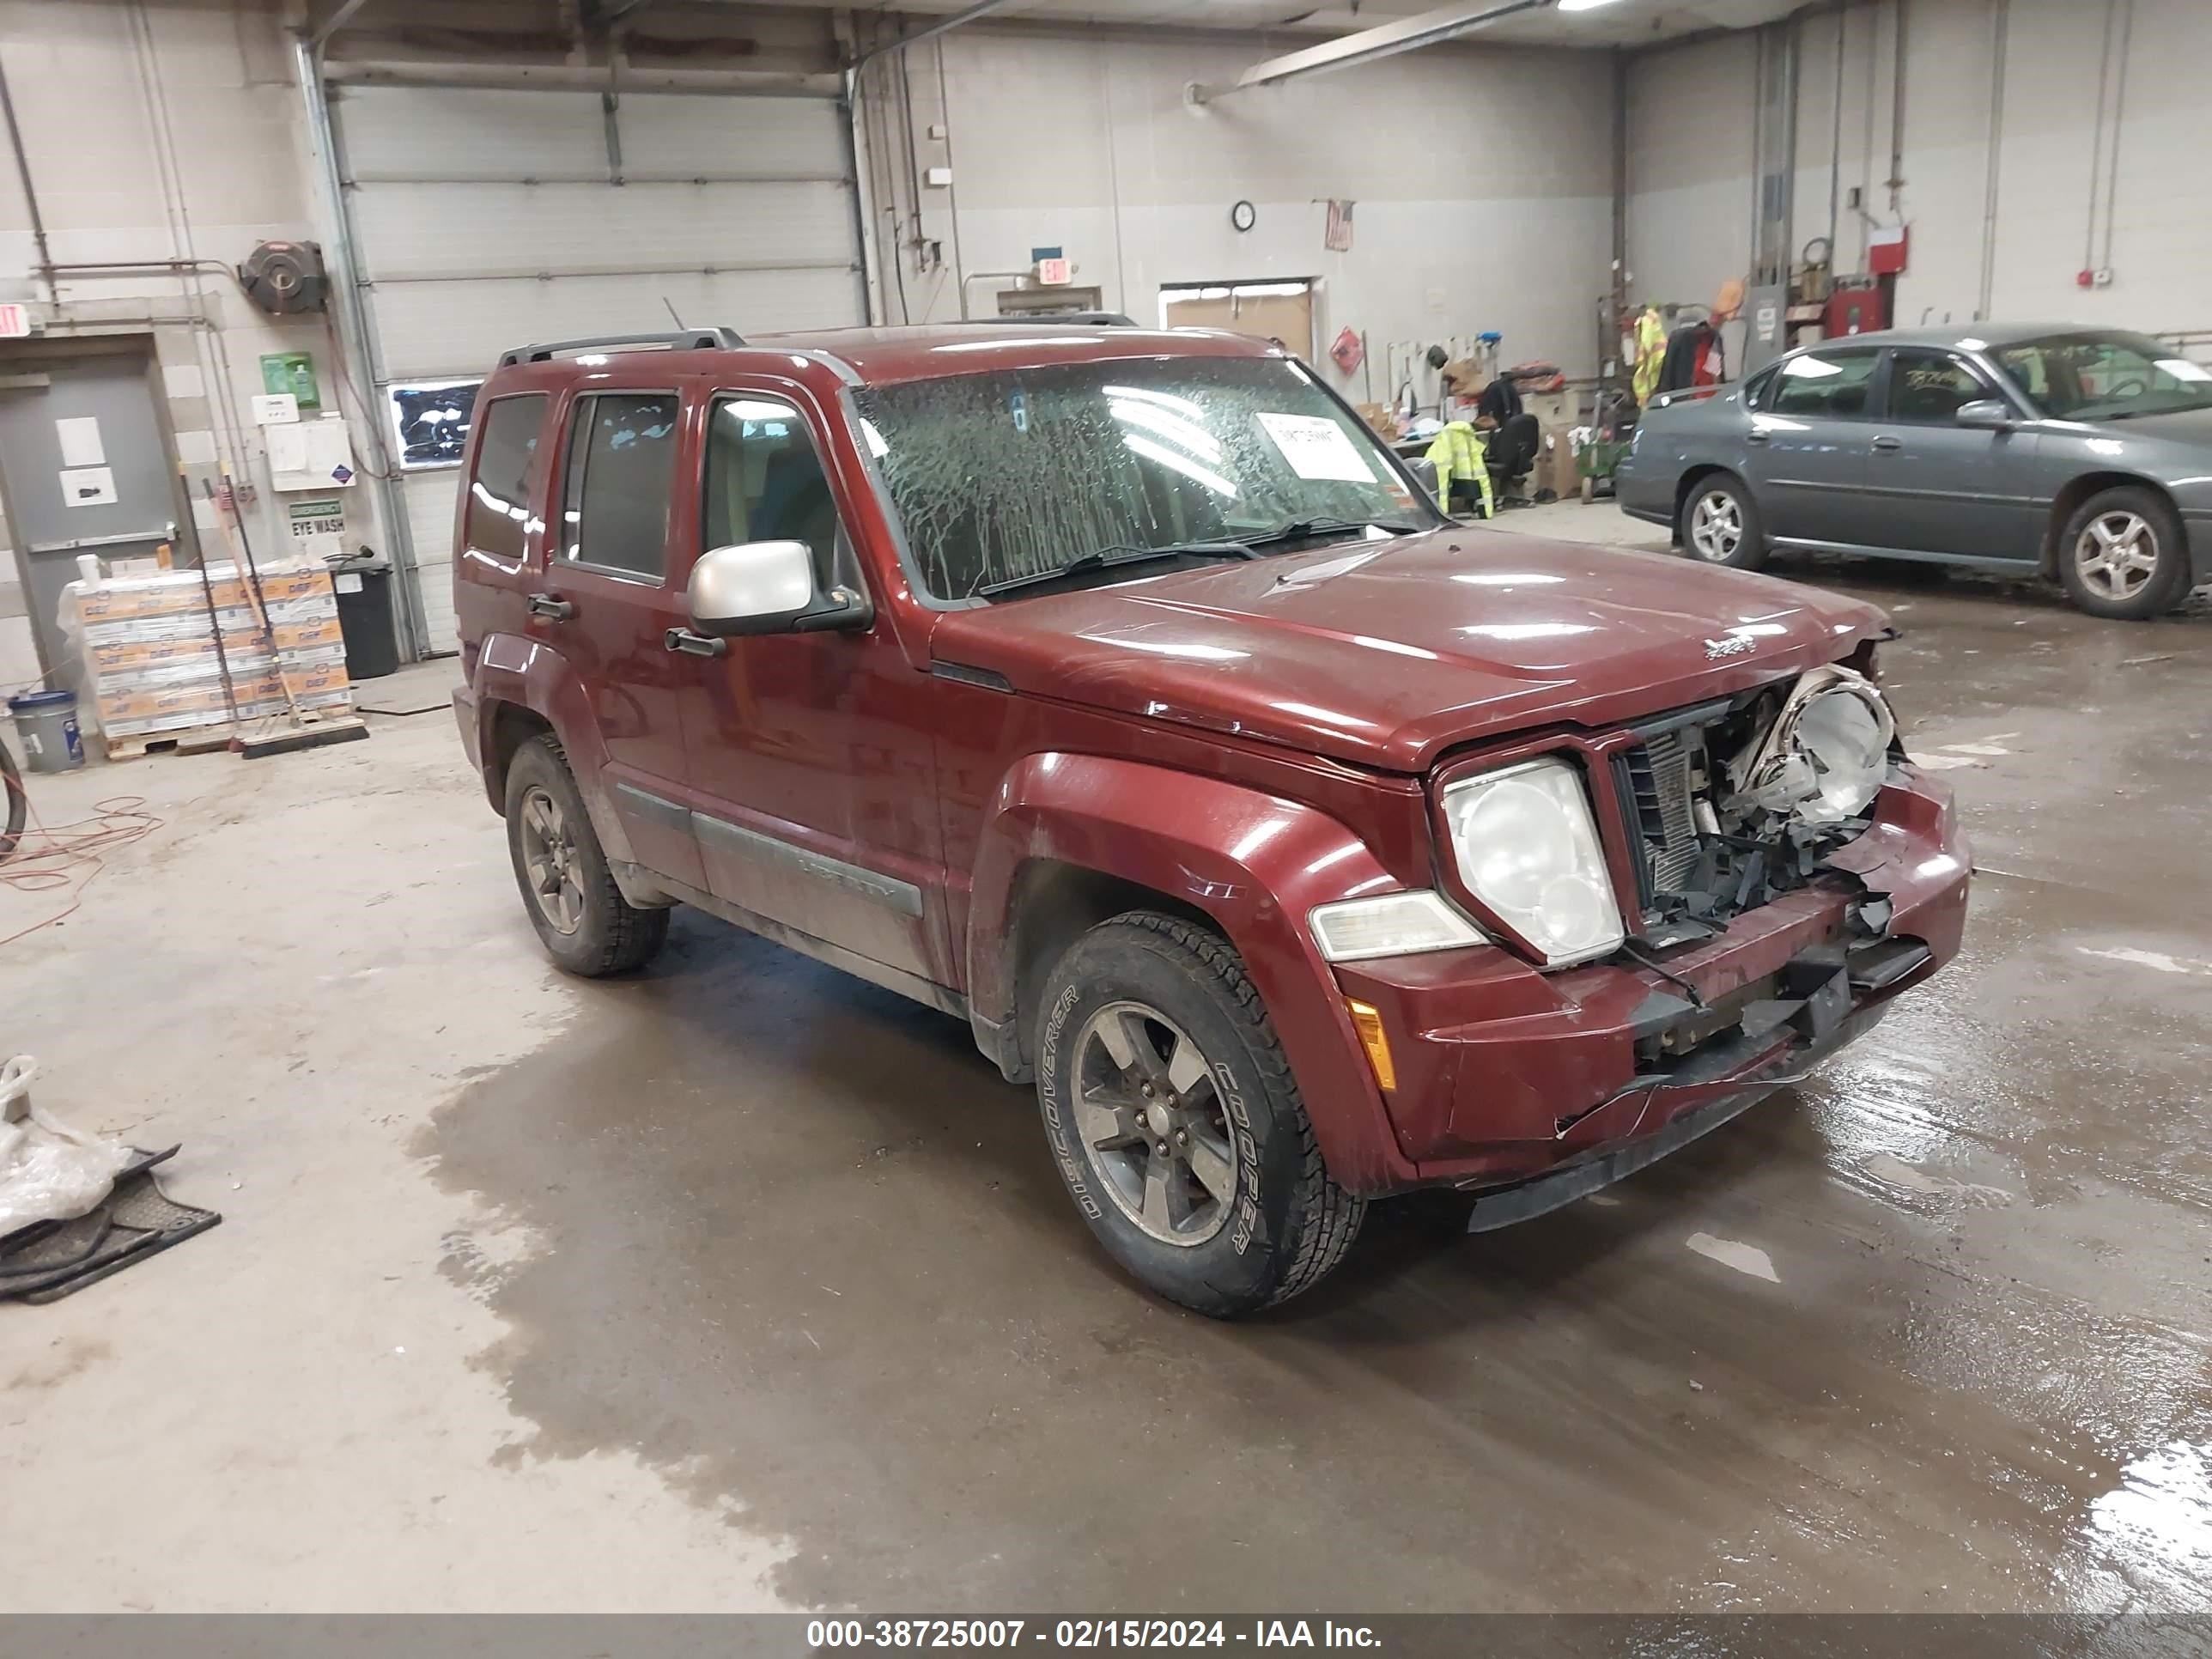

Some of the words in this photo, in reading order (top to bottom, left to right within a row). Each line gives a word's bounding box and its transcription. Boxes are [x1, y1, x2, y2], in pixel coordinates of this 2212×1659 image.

[292, 521, 313, 537] EYE
[314, 518, 345, 534] WASH
[289, 582, 311, 594] DEF
[1042, 984, 1103, 1220] DISCOVERER
[1215, 1062, 1260, 1255] COOPER
